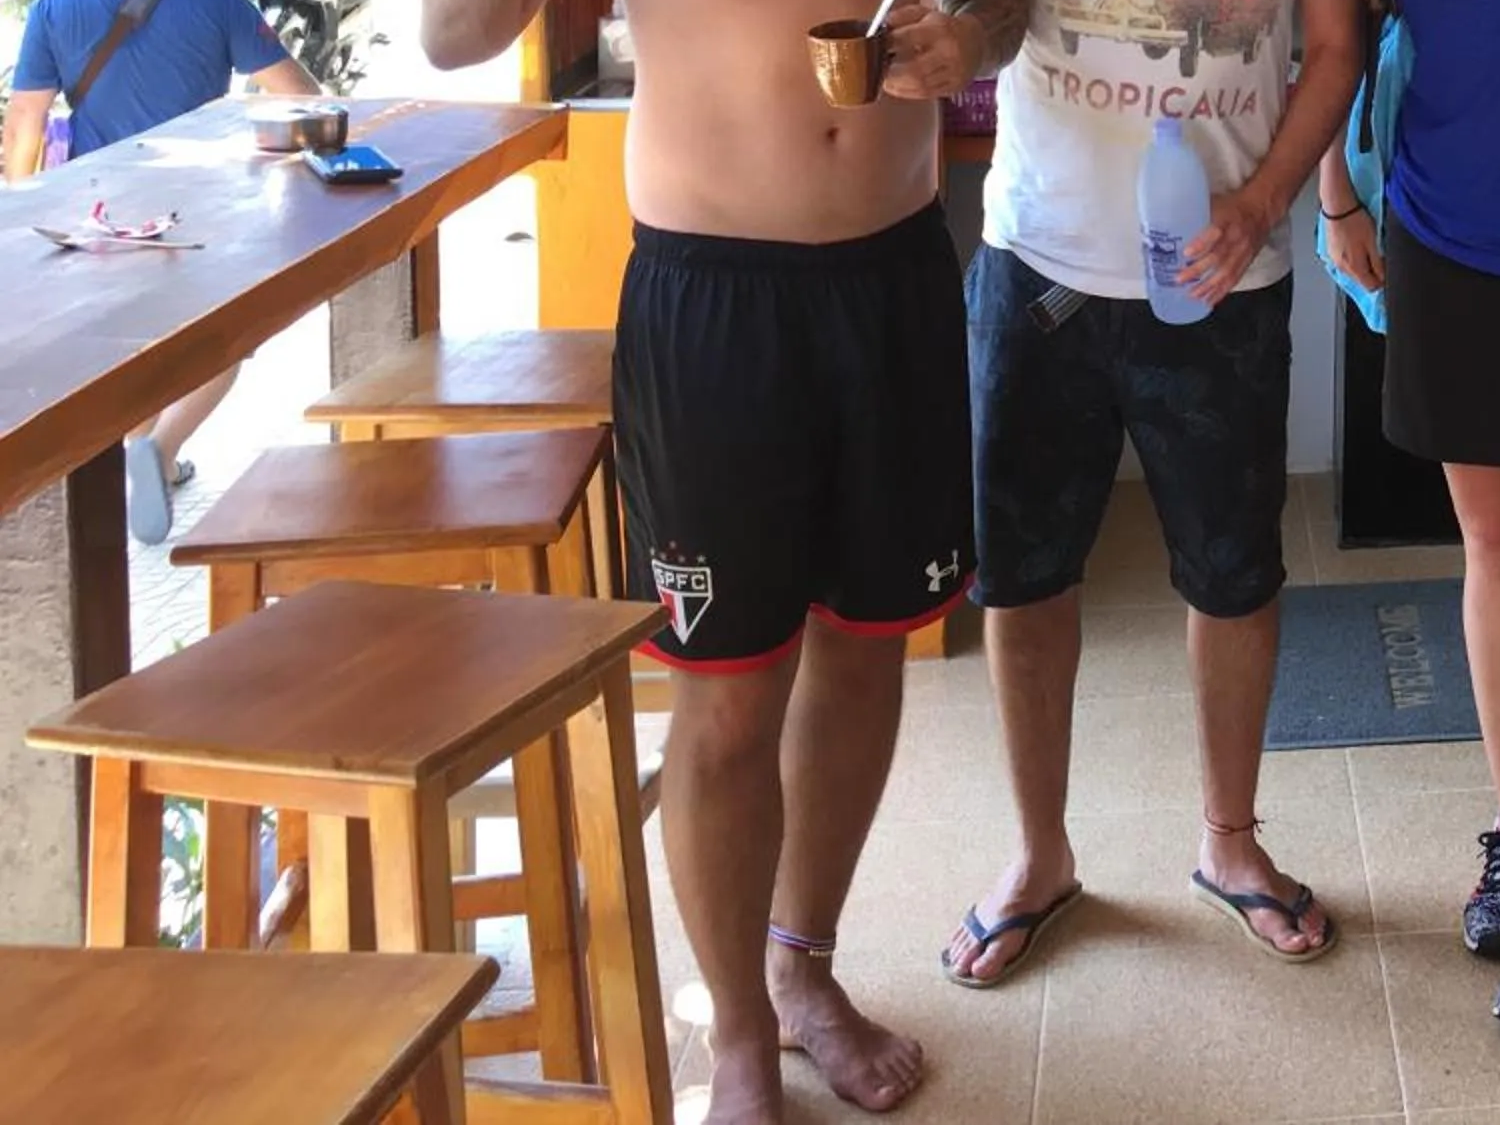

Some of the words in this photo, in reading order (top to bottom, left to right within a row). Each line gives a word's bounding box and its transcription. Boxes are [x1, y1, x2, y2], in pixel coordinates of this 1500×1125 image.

[1042, 65, 1256, 118] TROPICALIA
[655, 568, 706, 590] SPFC
[1377, 603, 1437, 709] WELCOME
